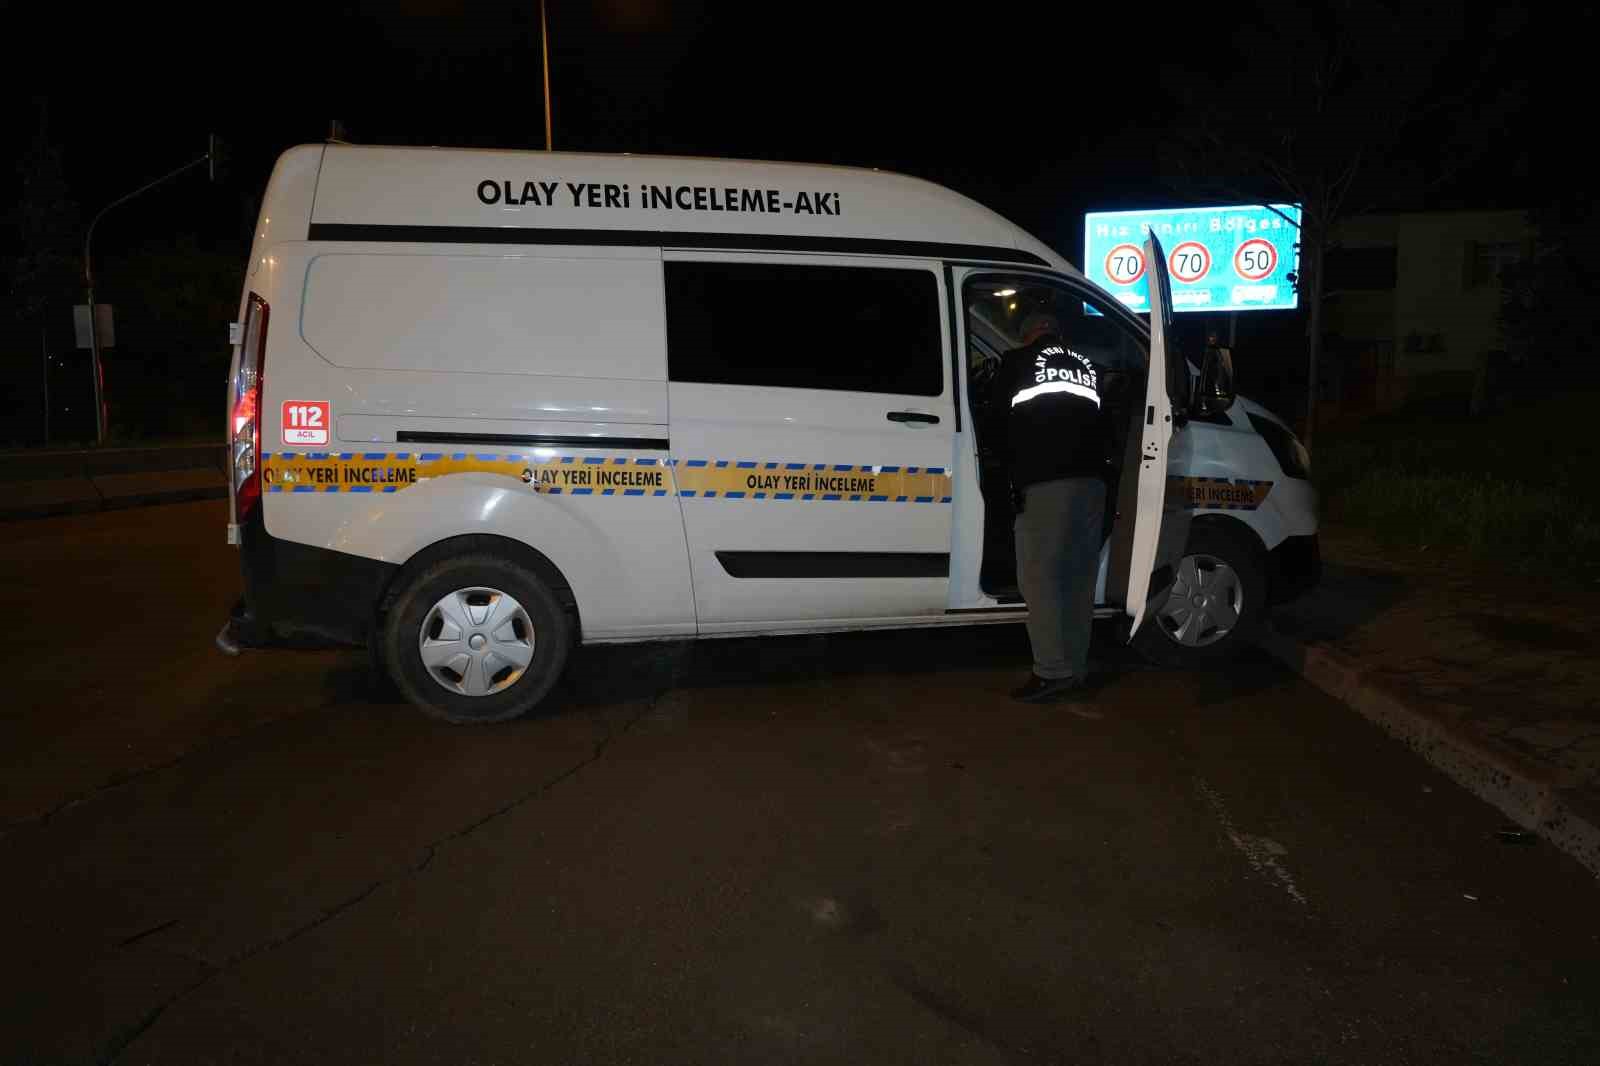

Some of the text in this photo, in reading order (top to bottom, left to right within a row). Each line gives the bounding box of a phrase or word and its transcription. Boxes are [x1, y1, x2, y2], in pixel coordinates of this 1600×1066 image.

[476, 179, 558, 206] OLAY
[1113, 255, 1139, 276] 70
[1177, 253, 1203, 274] 70
[1244, 250, 1270, 271] 50
[1034, 354, 1048, 383] OLAY
[288, 406, 323, 427] 112
[746, 474, 780, 489] OLAY
